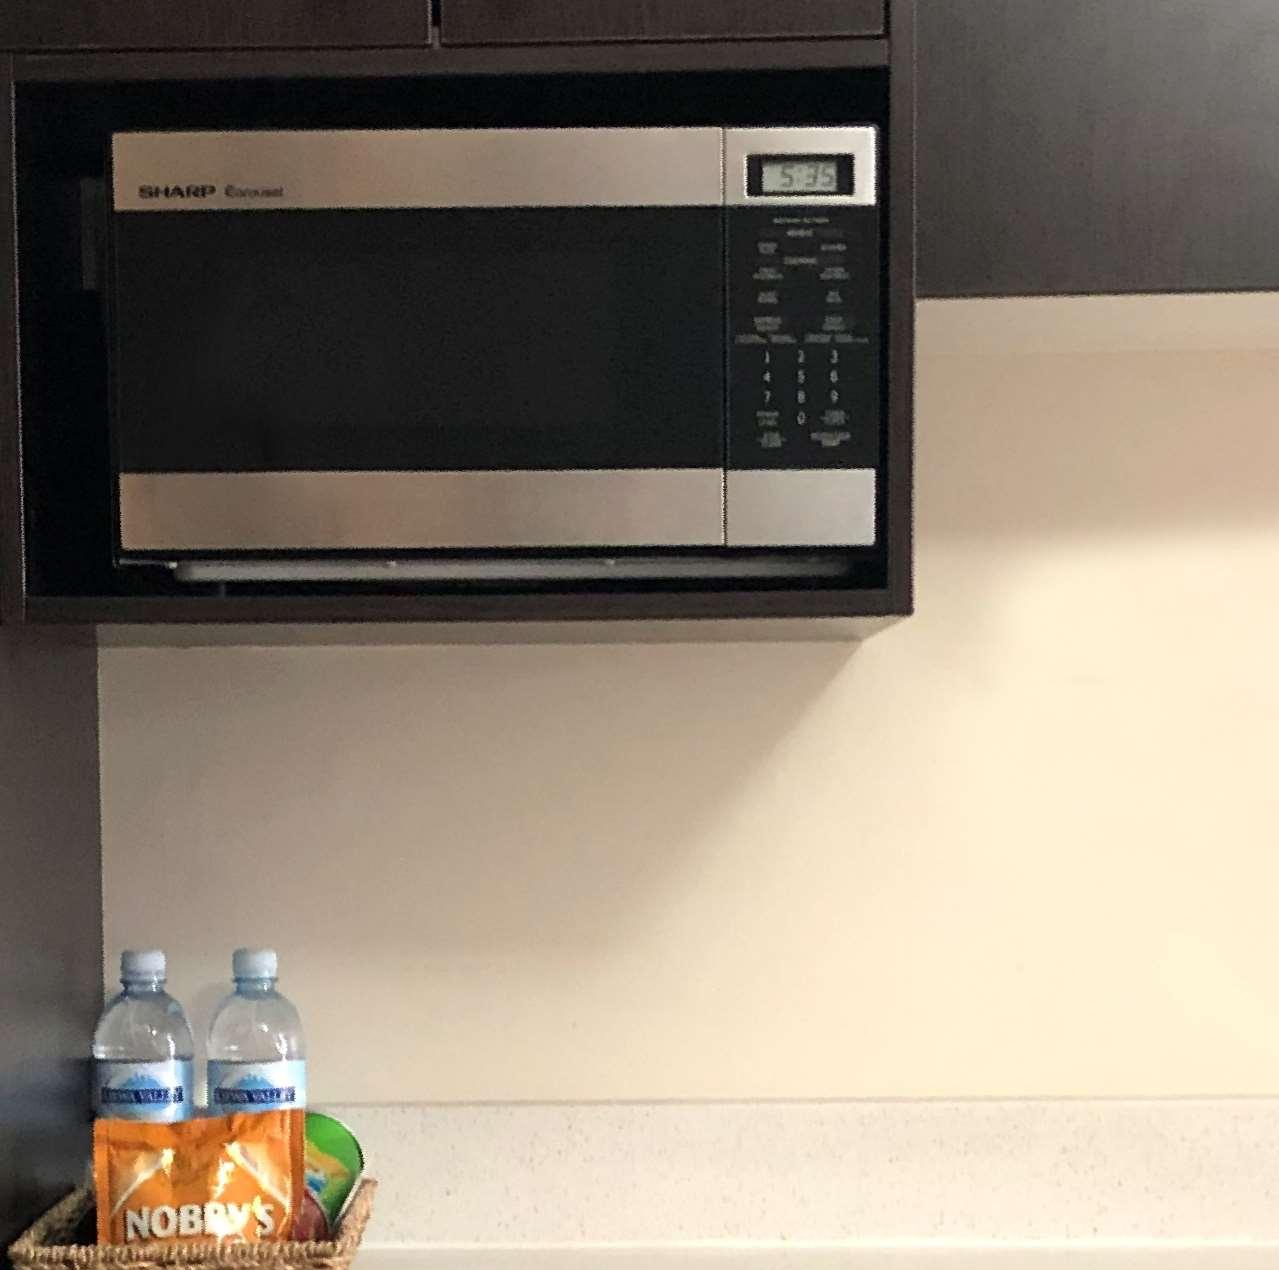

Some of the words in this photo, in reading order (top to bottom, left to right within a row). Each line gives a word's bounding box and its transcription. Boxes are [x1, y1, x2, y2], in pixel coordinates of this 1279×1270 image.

[780, 163, 835, 187] 5:35
[138, 184, 216, 199] SHARP
[125, 1199, 275, 1242] NOBBY'S
